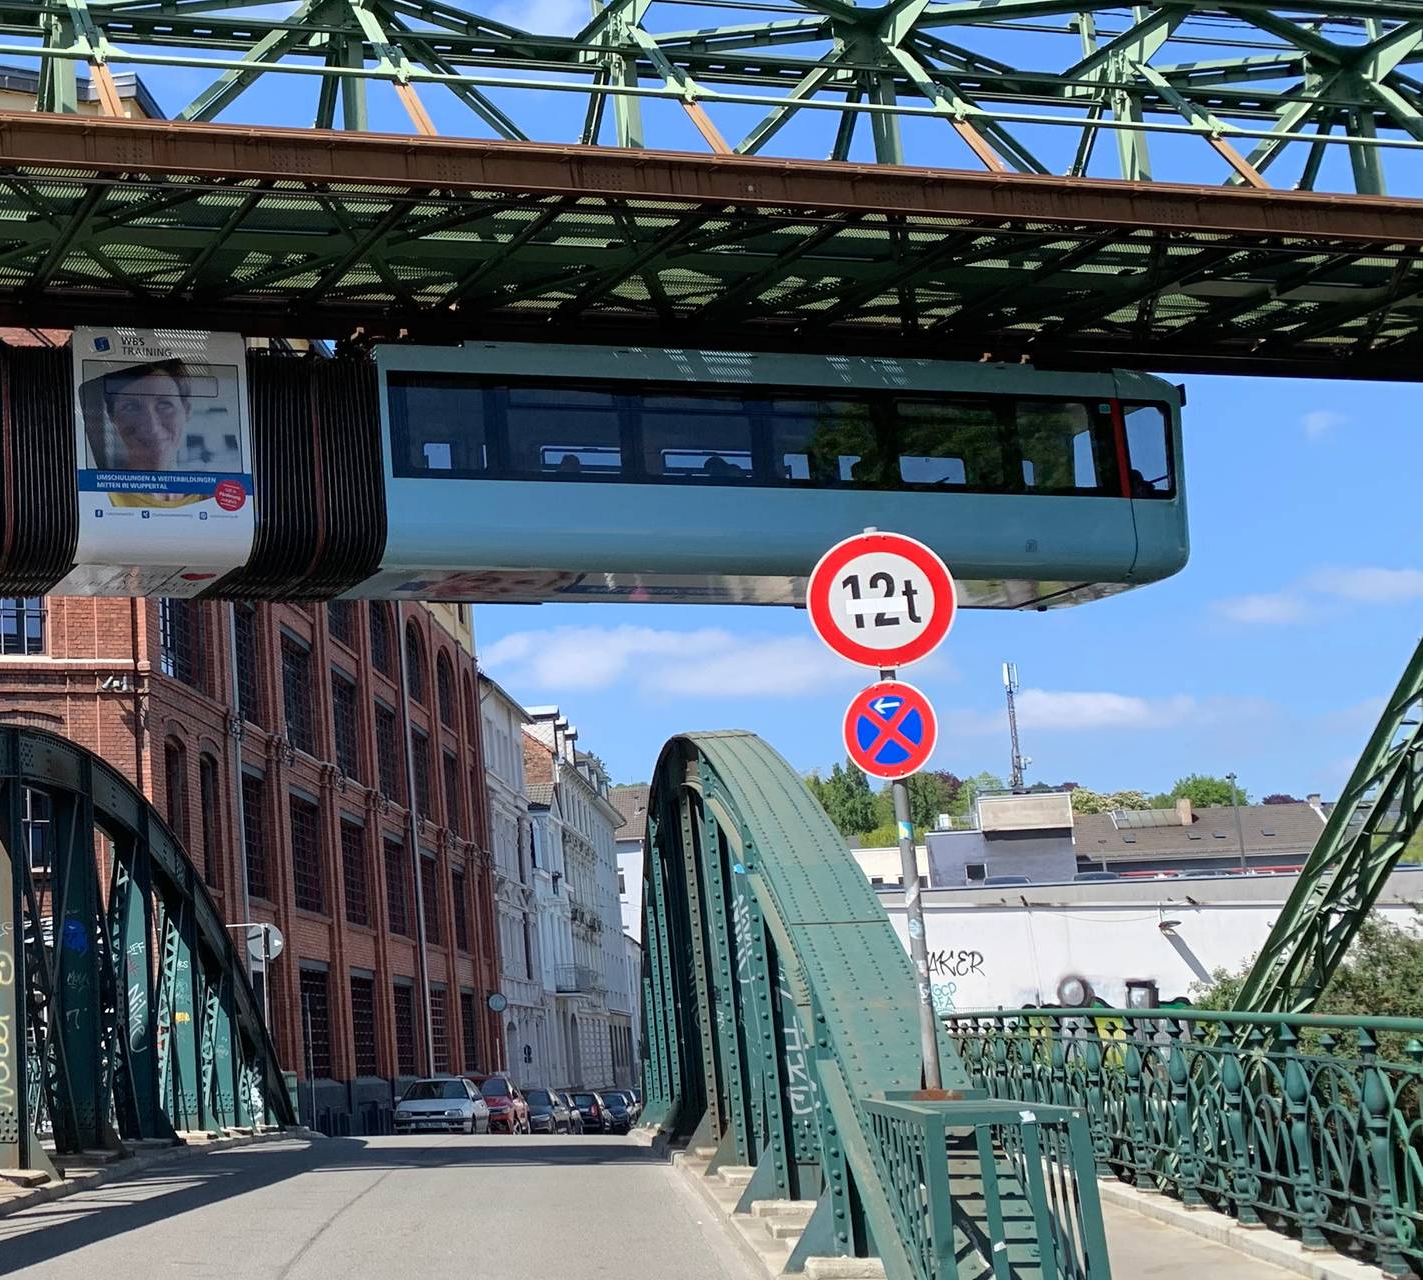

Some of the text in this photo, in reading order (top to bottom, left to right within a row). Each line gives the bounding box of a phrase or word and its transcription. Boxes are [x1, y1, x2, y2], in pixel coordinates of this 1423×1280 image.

[121, 346, 172, 357] TRAINING
[96, 474, 151, 482] UMSCHULUNGEN
[158, 475, 217, 484] WEITERBILDUNGEN
[842, 572, 922, 629] 12t
[926, 950, 986, 977] AKER
